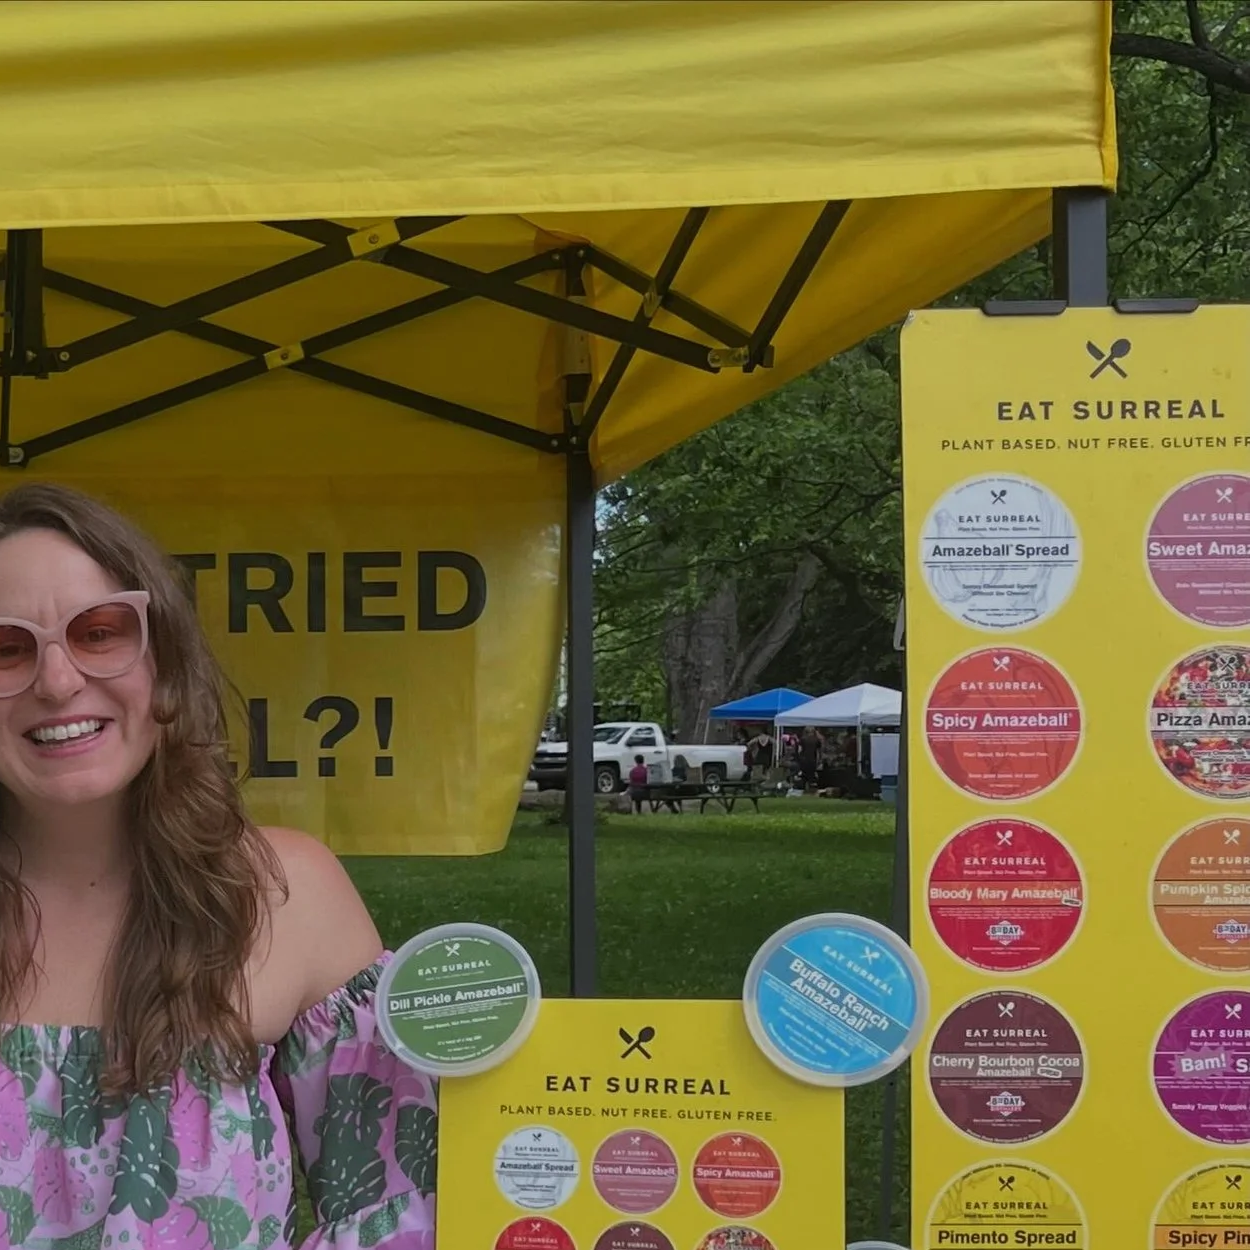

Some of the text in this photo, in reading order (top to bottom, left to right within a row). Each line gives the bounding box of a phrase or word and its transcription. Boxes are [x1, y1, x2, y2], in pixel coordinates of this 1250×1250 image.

[997, 399, 1225, 422] EAT SURREAL
[941, 438, 995, 451] PLANT
[1001, 438, 1061, 450] BASED.
[1067, 438, 1100, 449] NUT
[1107, 437, 1154, 449] FREE.
[1161, 437, 1227, 448] GLUTEN
[931, 543, 1070, 560] Amazeball Spread
[1148, 541, 1203, 557] Sweet
[931, 712, 1069, 730] Spicy Amazeball
[1156, 712, 1202, 727] Pizza
[929, 887, 973, 901] Bloody
[976, 887, 1007, 901] Mary
[389, 982, 521, 1011] Dill Pickle Amazeball
[788, 957, 841, 998] Buffalo
[842, 992, 890, 1031] Ranch
[790, 977, 868, 1032] Amazeball
[932, 1054, 1080, 1069] Cherry Bourbon Cocoa
[1180, 1053, 1227, 1073] Bam!
[545, 1074, 732, 1096] EAT SURREAL
[499, 1104, 777, 1122] PLANT BASED. NUT FREE. GLUTEN FREE.
[937, 1229, 1077, 1248] Pimento Spread
[1168, 1230, 1218, 1248] Spicy
